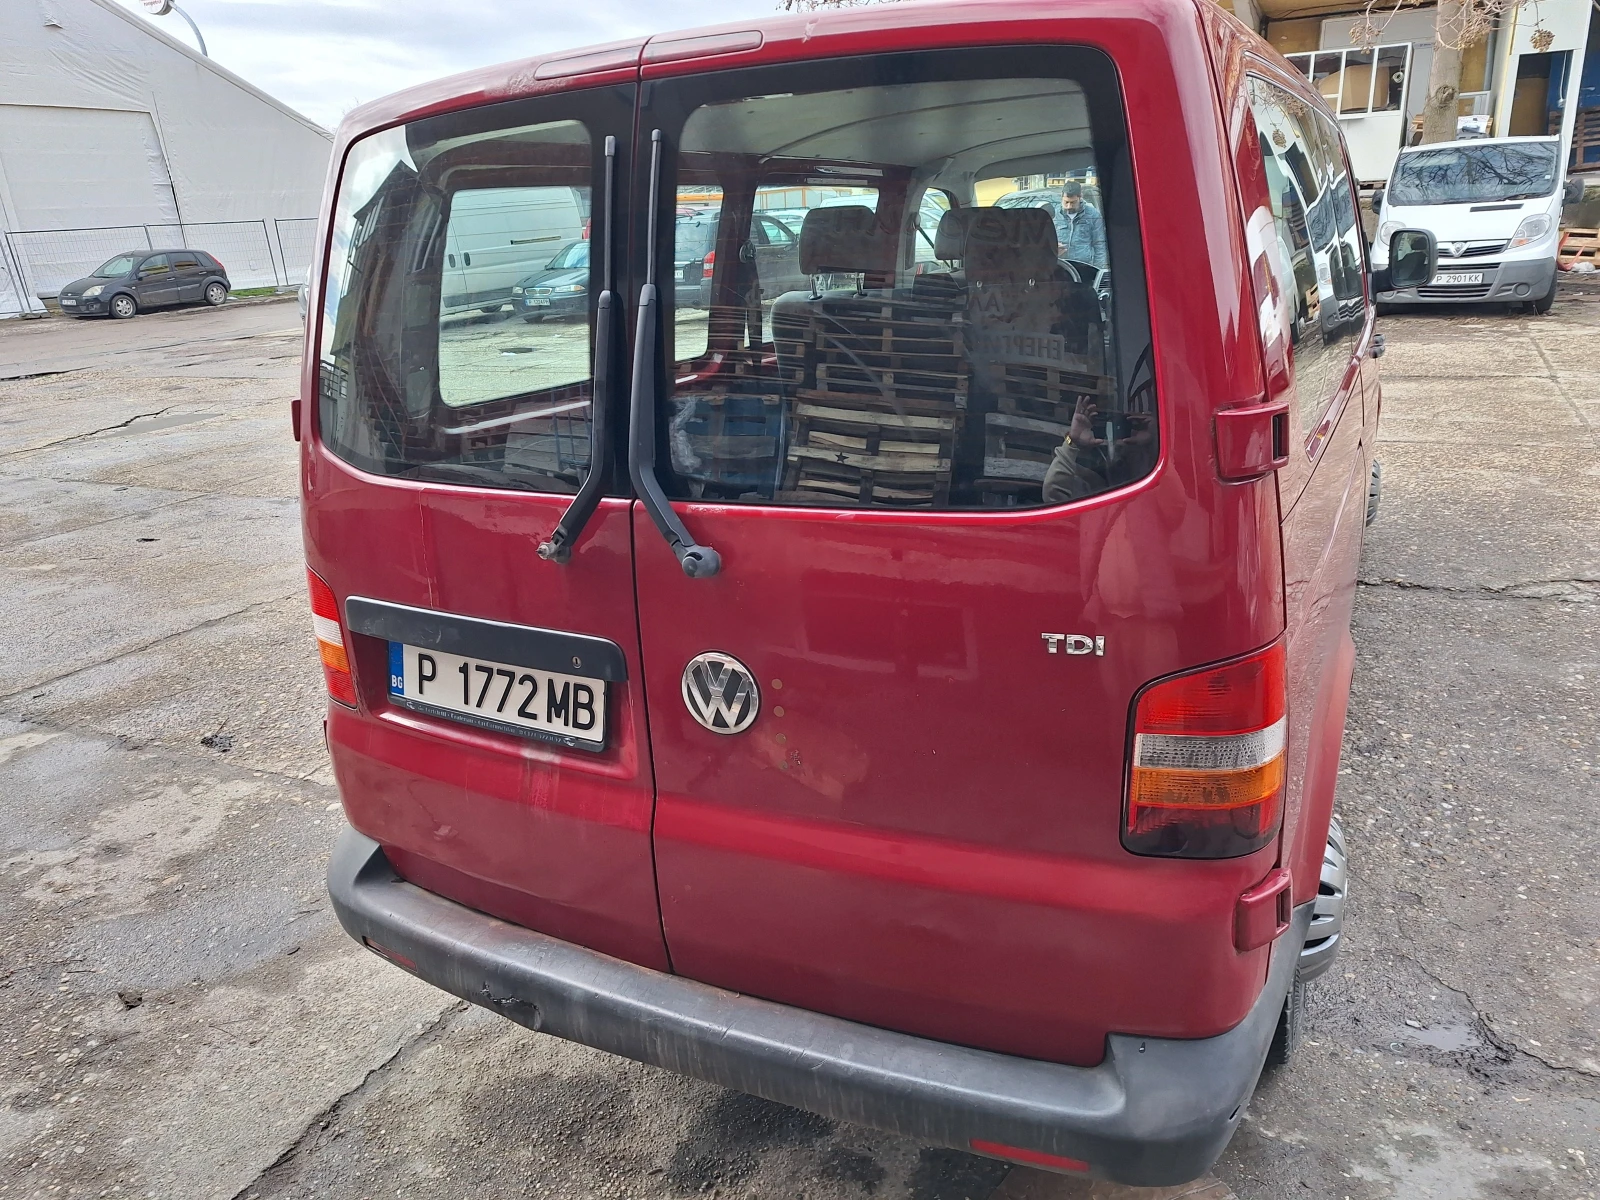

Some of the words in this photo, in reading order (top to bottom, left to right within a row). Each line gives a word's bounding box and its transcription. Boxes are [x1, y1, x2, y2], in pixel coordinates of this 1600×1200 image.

[1436, 275, 1442, 283] P
[1446, 274, 1480, 283] 2901KK
[1041, 632, 1105, 656] TDI
[391, 674, 403, 689] BG
[418, 652, 437, 695] P
